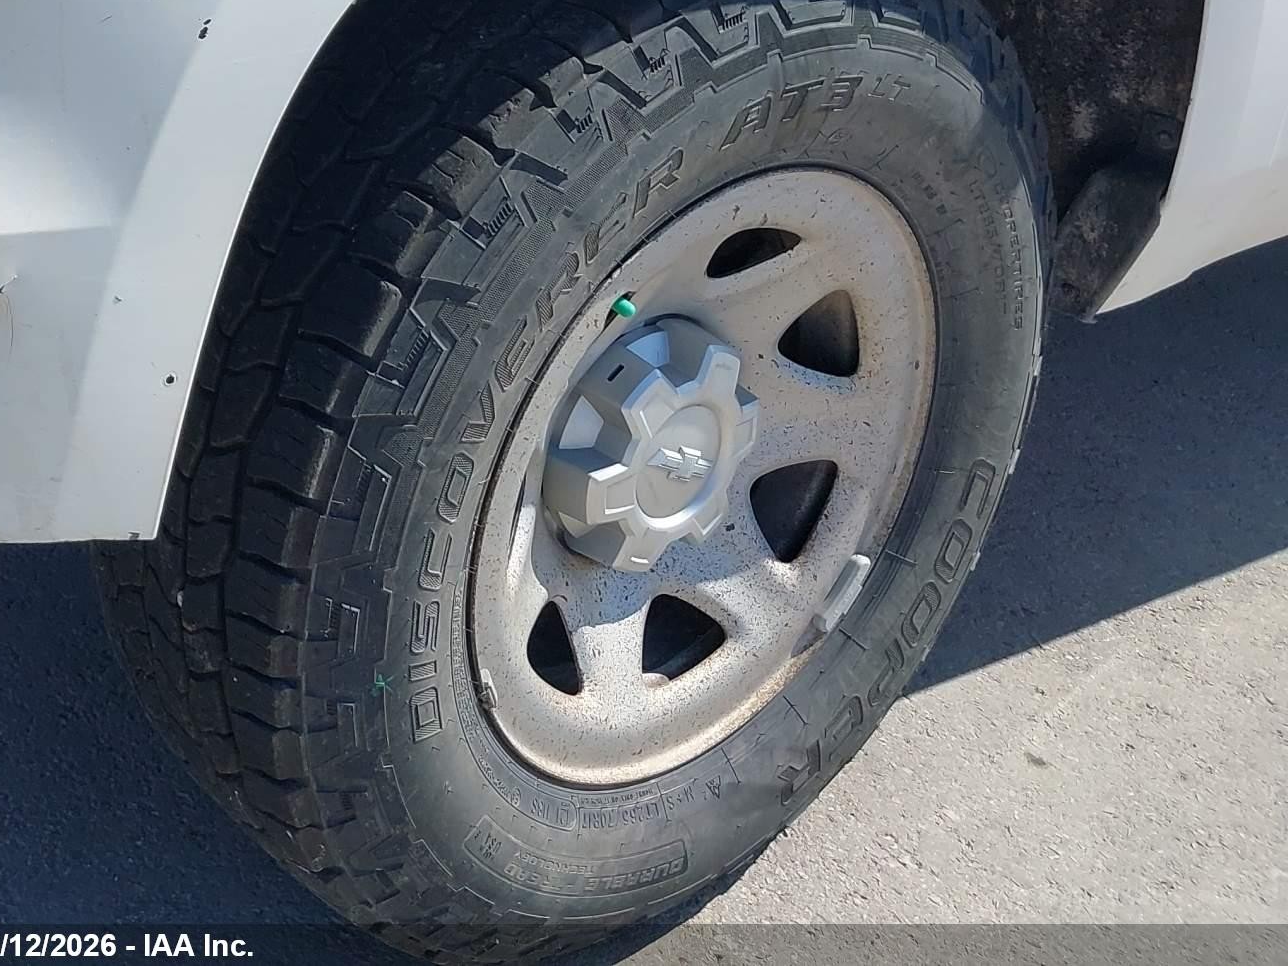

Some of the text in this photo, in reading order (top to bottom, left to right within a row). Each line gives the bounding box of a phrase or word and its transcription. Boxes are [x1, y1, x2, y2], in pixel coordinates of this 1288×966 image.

[409, 145, 685, 743] DISCOVERER
[719, 73, 864, 152] AT3
[867, 76, 912, 103] LT
[779, 456, 997, 807] COOPER
[513, 848, 597, 876] TECHNOLOGY
